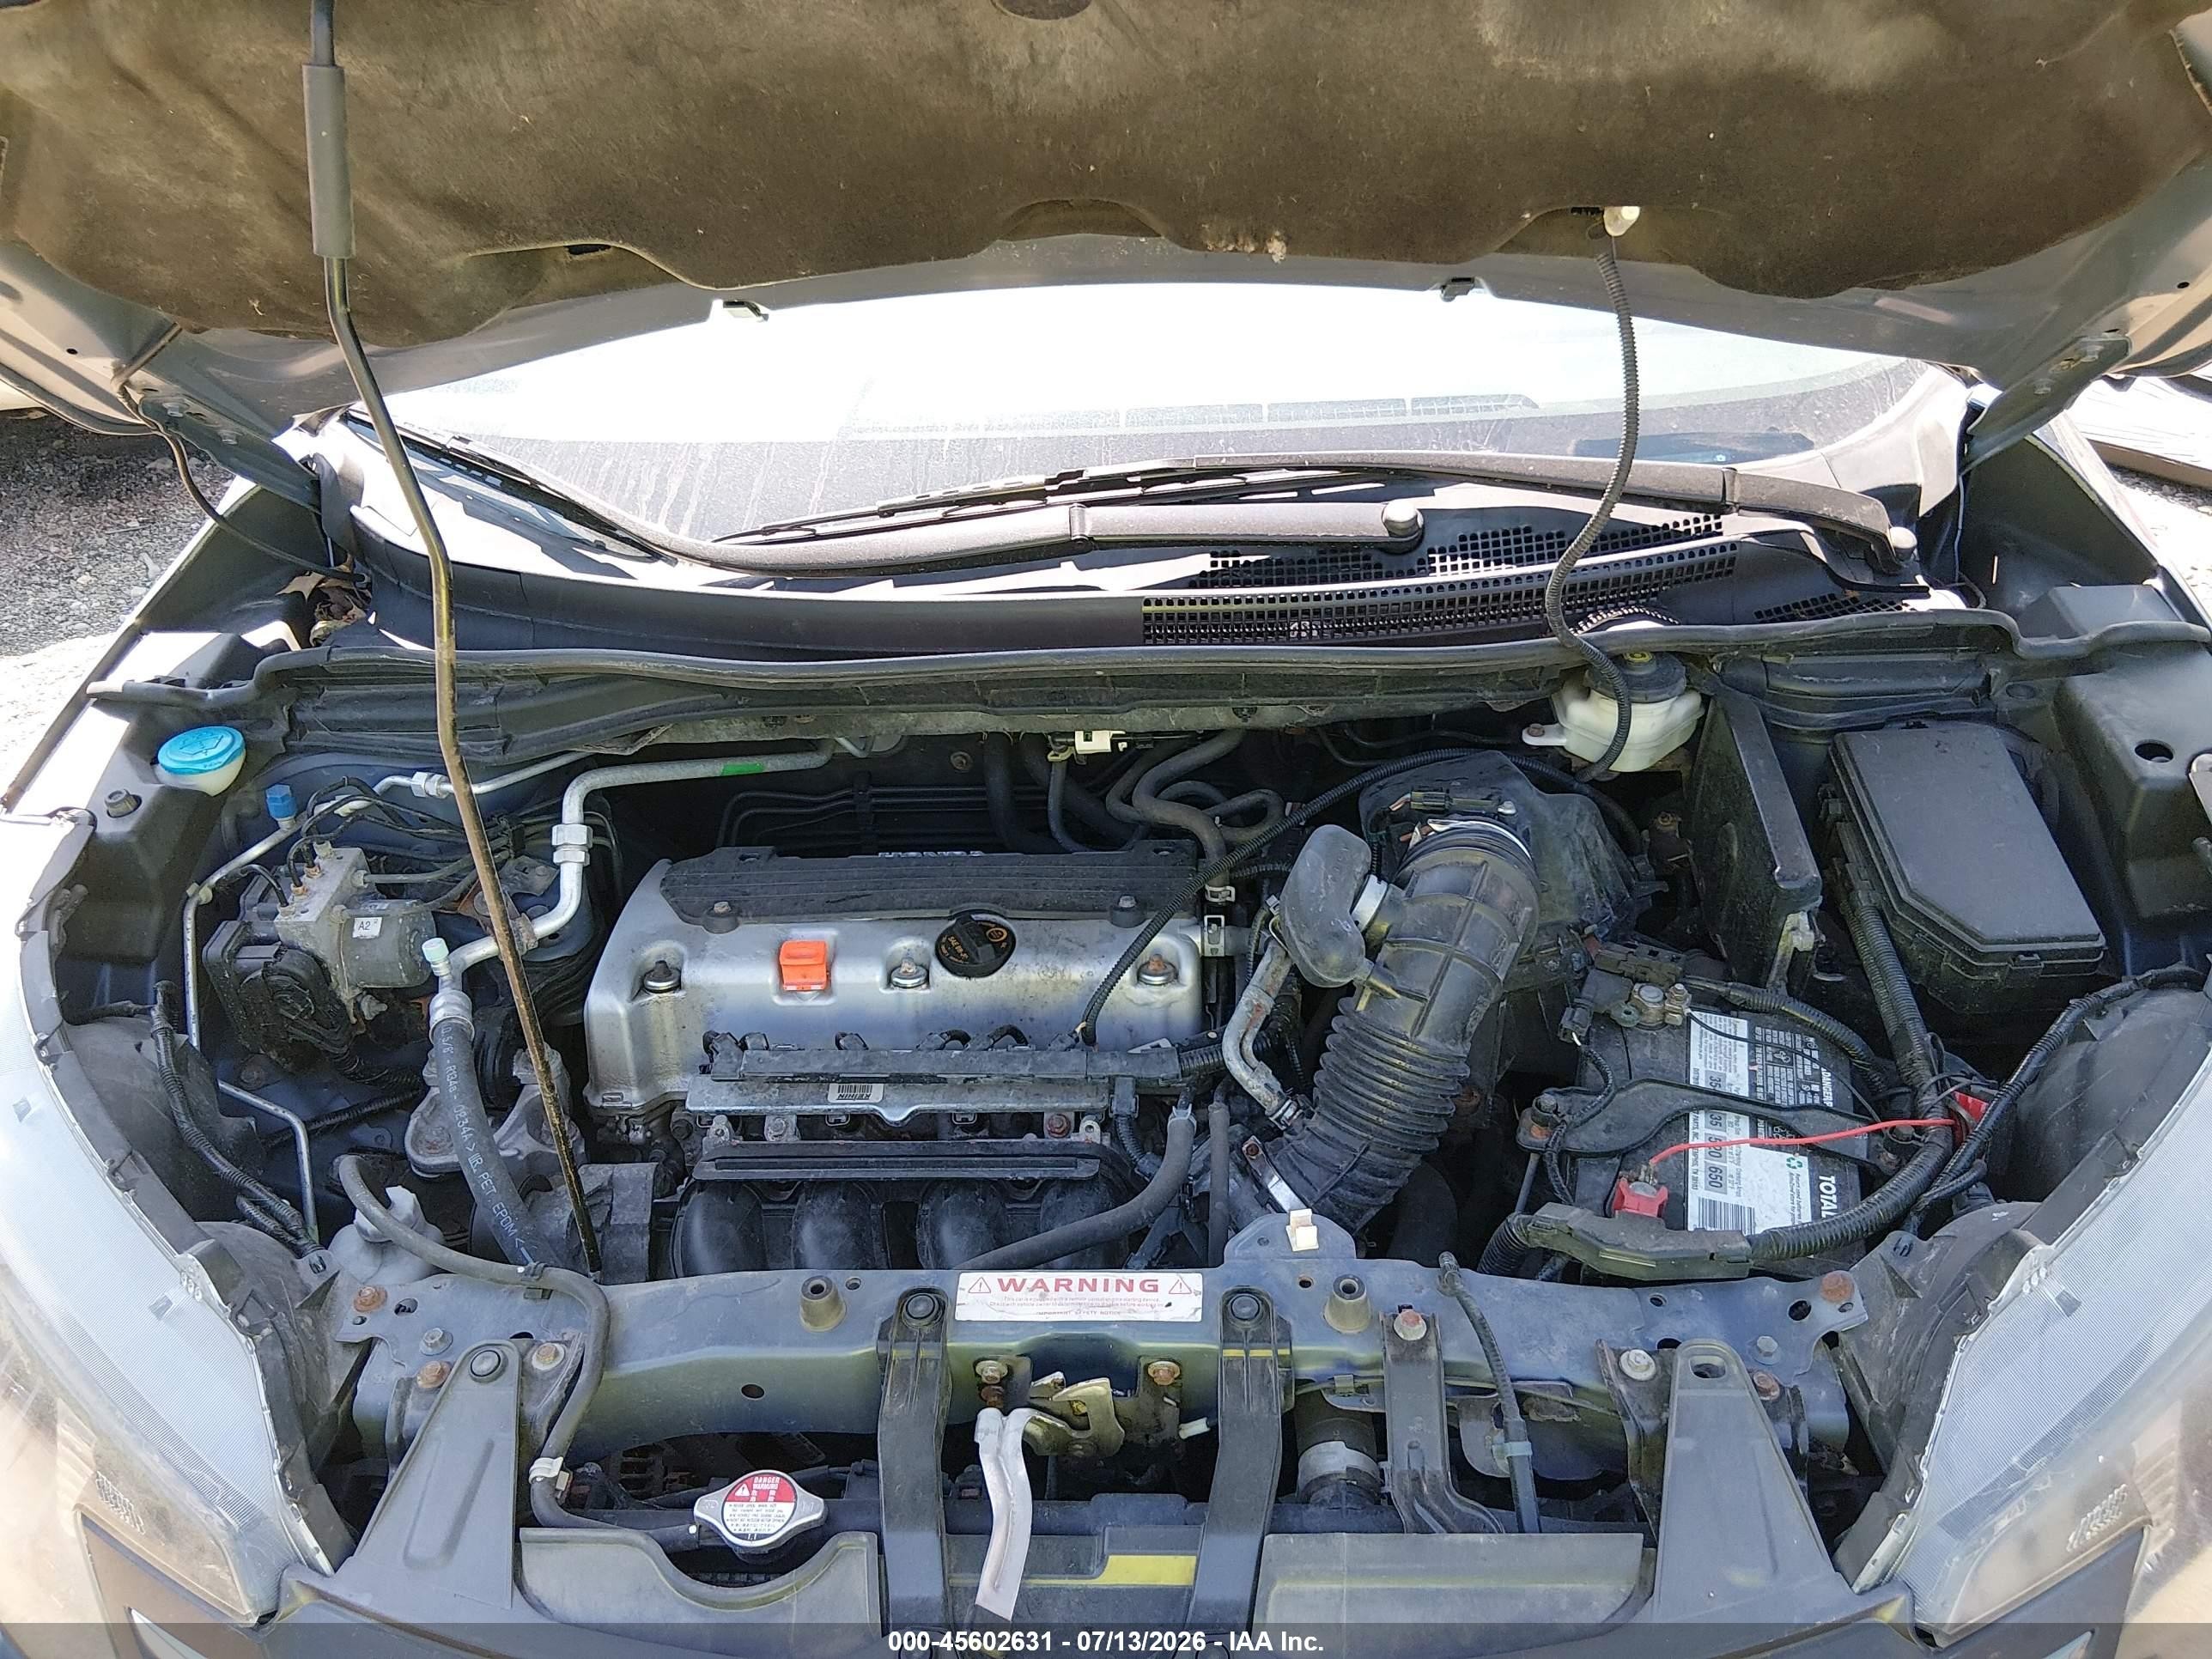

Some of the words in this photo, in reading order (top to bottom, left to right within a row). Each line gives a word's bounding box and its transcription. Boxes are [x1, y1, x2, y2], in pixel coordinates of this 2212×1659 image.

[358, 921, 371, 931] A2
[1709, 1076, 1722, 1088] 35
[1710, 1114, 1722, 1127] 35
[1708, 1166, 1723, 1188] 650
[1819, 1175, 1838, 1218] TOTAL
[997, 1278, 1159, 1292] WARNING
